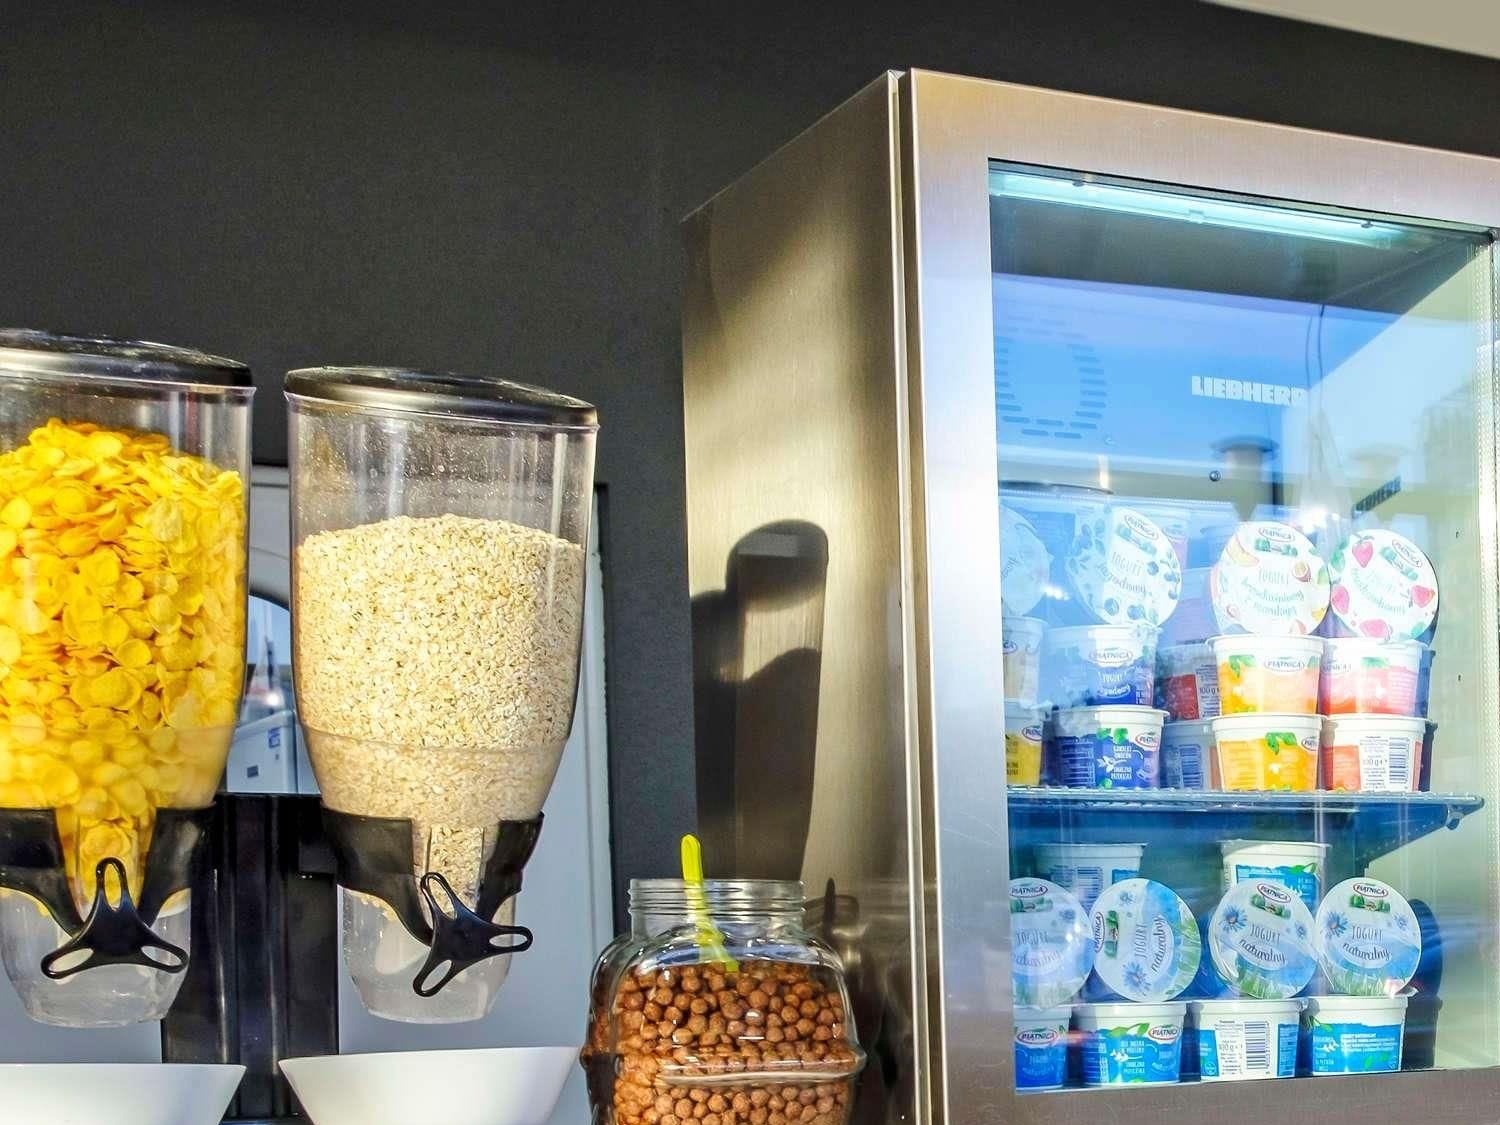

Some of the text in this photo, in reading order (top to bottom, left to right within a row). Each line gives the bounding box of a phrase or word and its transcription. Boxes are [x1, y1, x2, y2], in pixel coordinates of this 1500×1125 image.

[1259, 884, 1287, 900] PIĄTNICA
[1355, 884, 1386, 896] PIĄTNICA
[1135, 922, 1147, 960] JOGURT
[1251, 924, 1280, 942] JOGURT
[1352, 925, 1383, 941] JOGURT
[1151, 913, 1167, 974] naturalny
[1239, 938, 1286, 964] naturalny
[1344, 942, 1391, 961] naturalny
